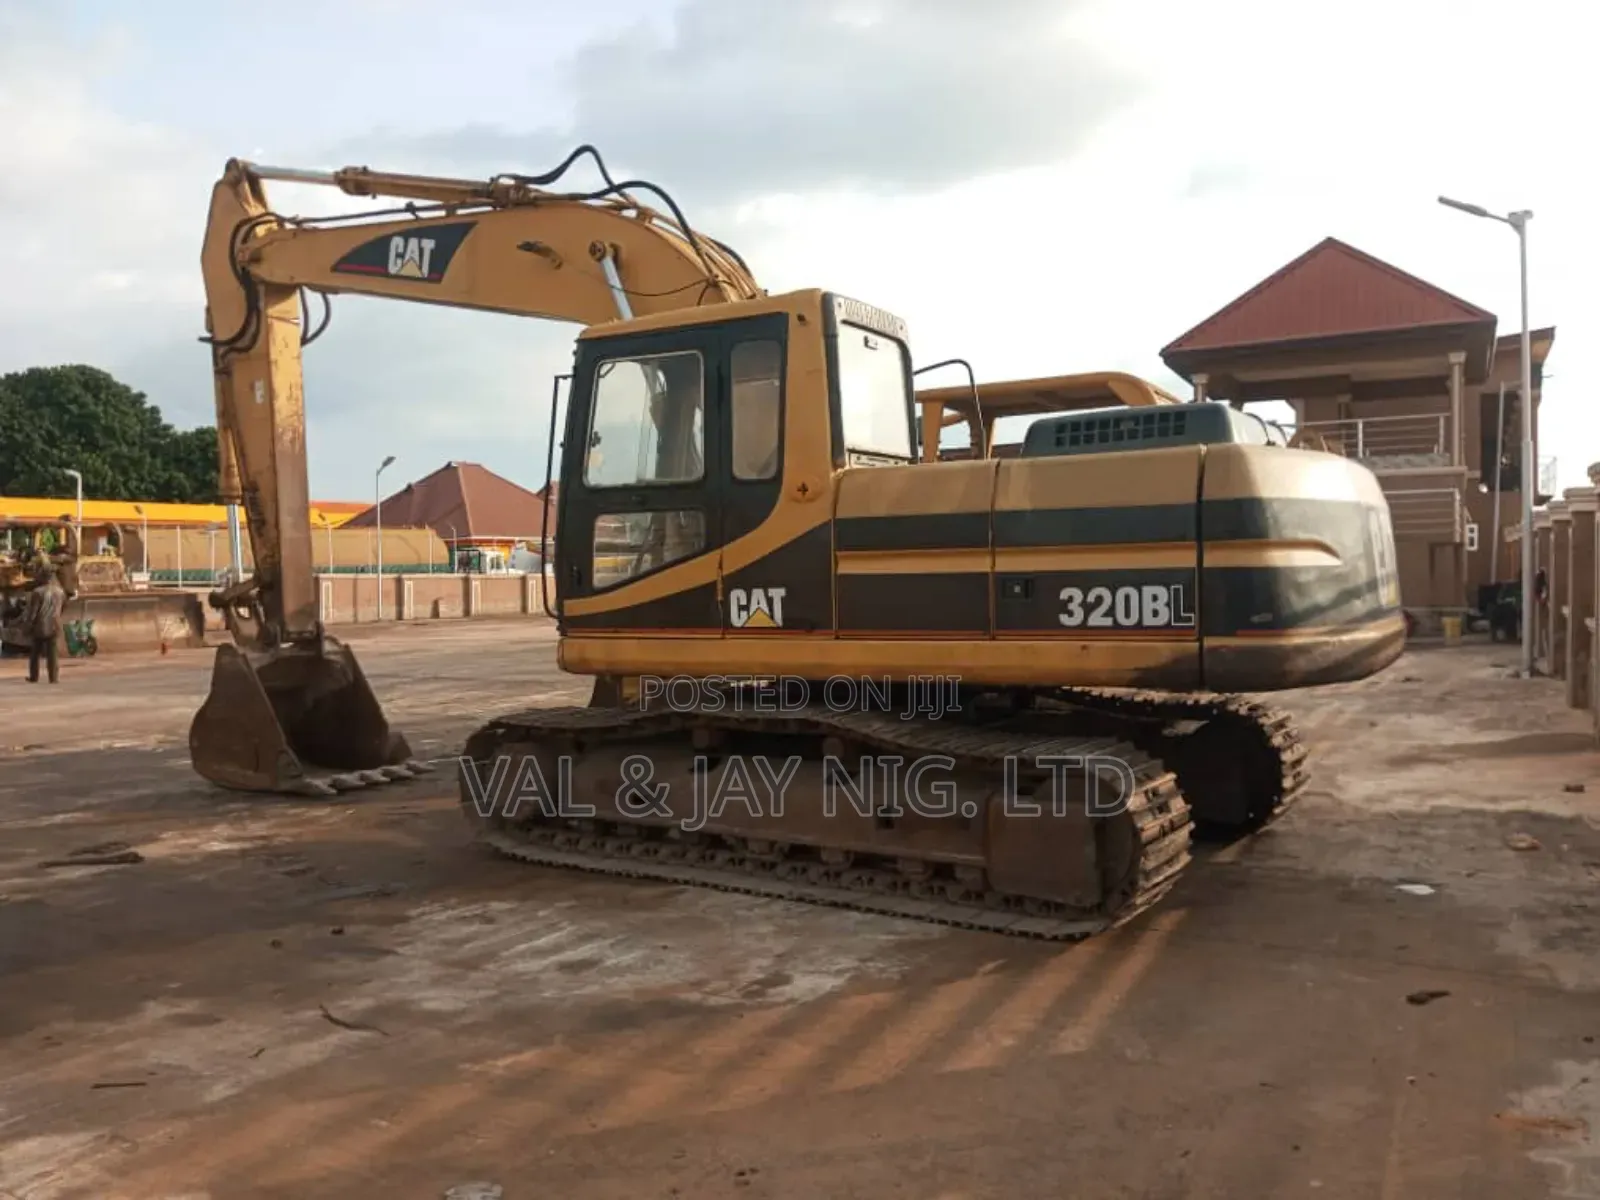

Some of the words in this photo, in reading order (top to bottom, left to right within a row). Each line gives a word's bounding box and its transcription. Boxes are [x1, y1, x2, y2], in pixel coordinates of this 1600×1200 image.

[388, 235, 436, 278] CAT
[729, 587, 786, 628] CAT
[1058, 584, 1195, 627] 320BL
